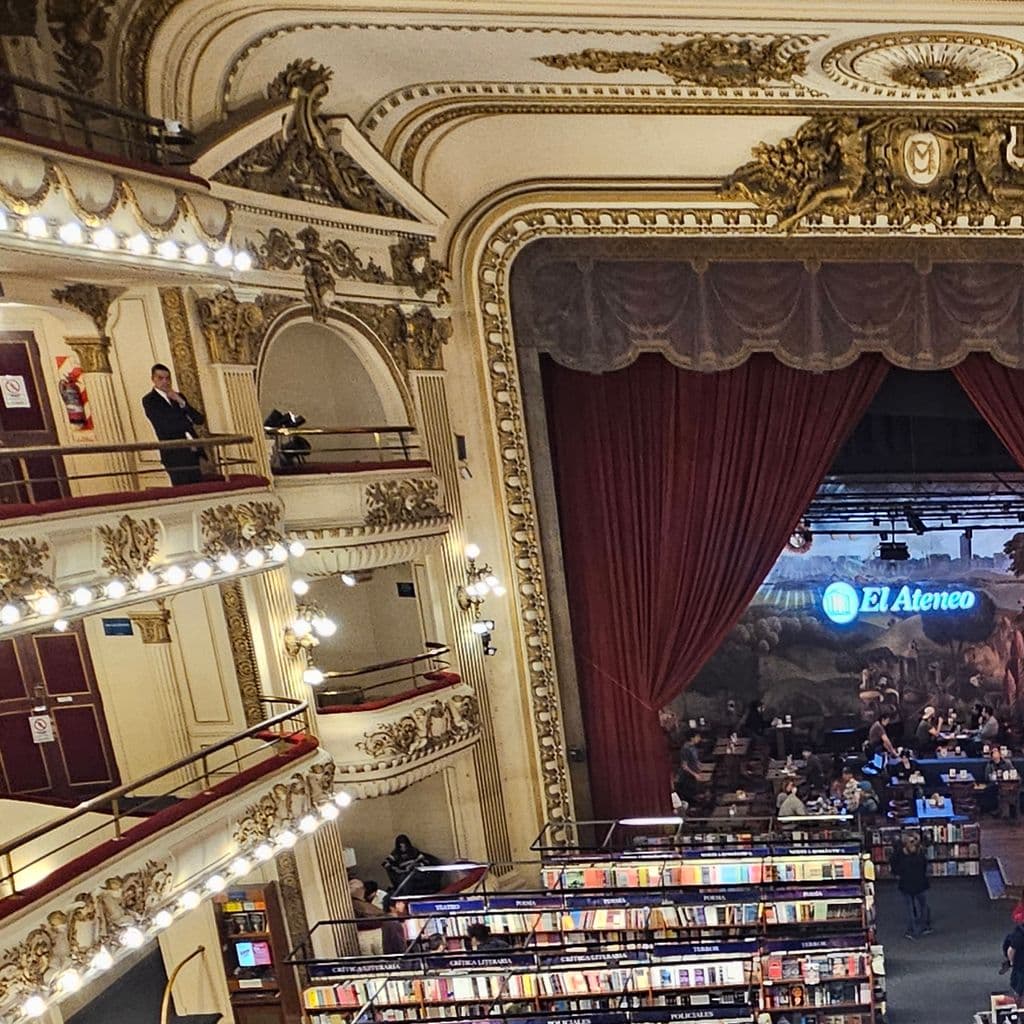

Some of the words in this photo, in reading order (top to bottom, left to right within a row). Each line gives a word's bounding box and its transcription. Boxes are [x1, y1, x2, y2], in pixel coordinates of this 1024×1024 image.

[859, 586, 890, 613] El
[891, 585, 975, 612] Ateneo
[692, 945, 720, 953] TERROR
[448, 958, 478, 968] CRÍTICA
[478, 957, 513, 966] LITERARIA
[670, 1010, 715, 1021] POLICIALES
